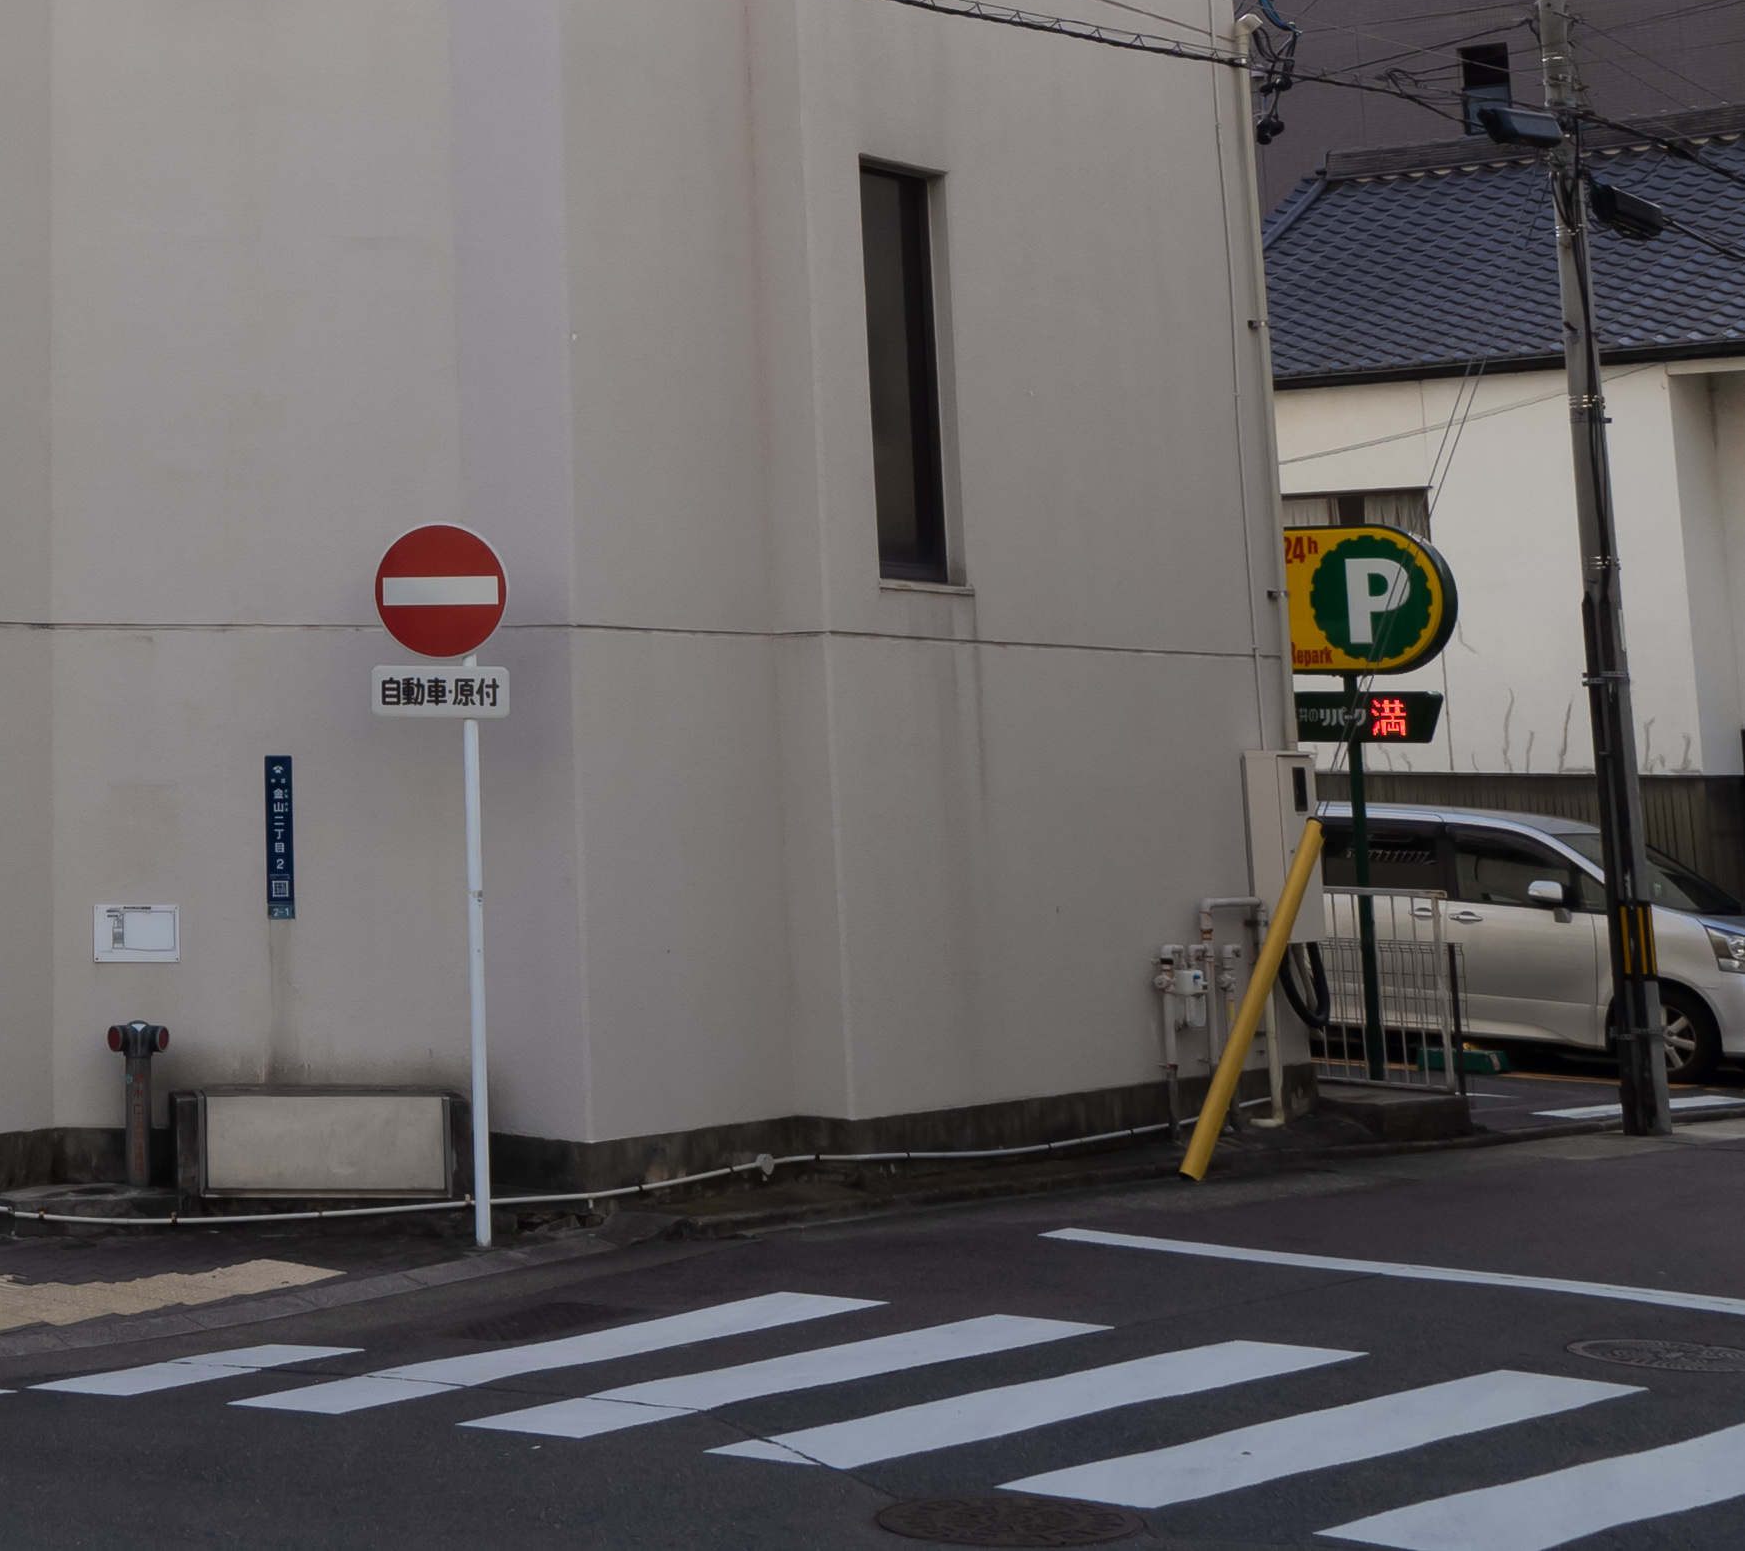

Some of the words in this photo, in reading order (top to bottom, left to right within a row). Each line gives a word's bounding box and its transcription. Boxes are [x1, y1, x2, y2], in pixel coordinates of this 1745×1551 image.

[1344, 558, 1411, 645] P
[1297, 706, 1367, 727] 井のリパーク
[1370, 699, 1407, 736] 満
